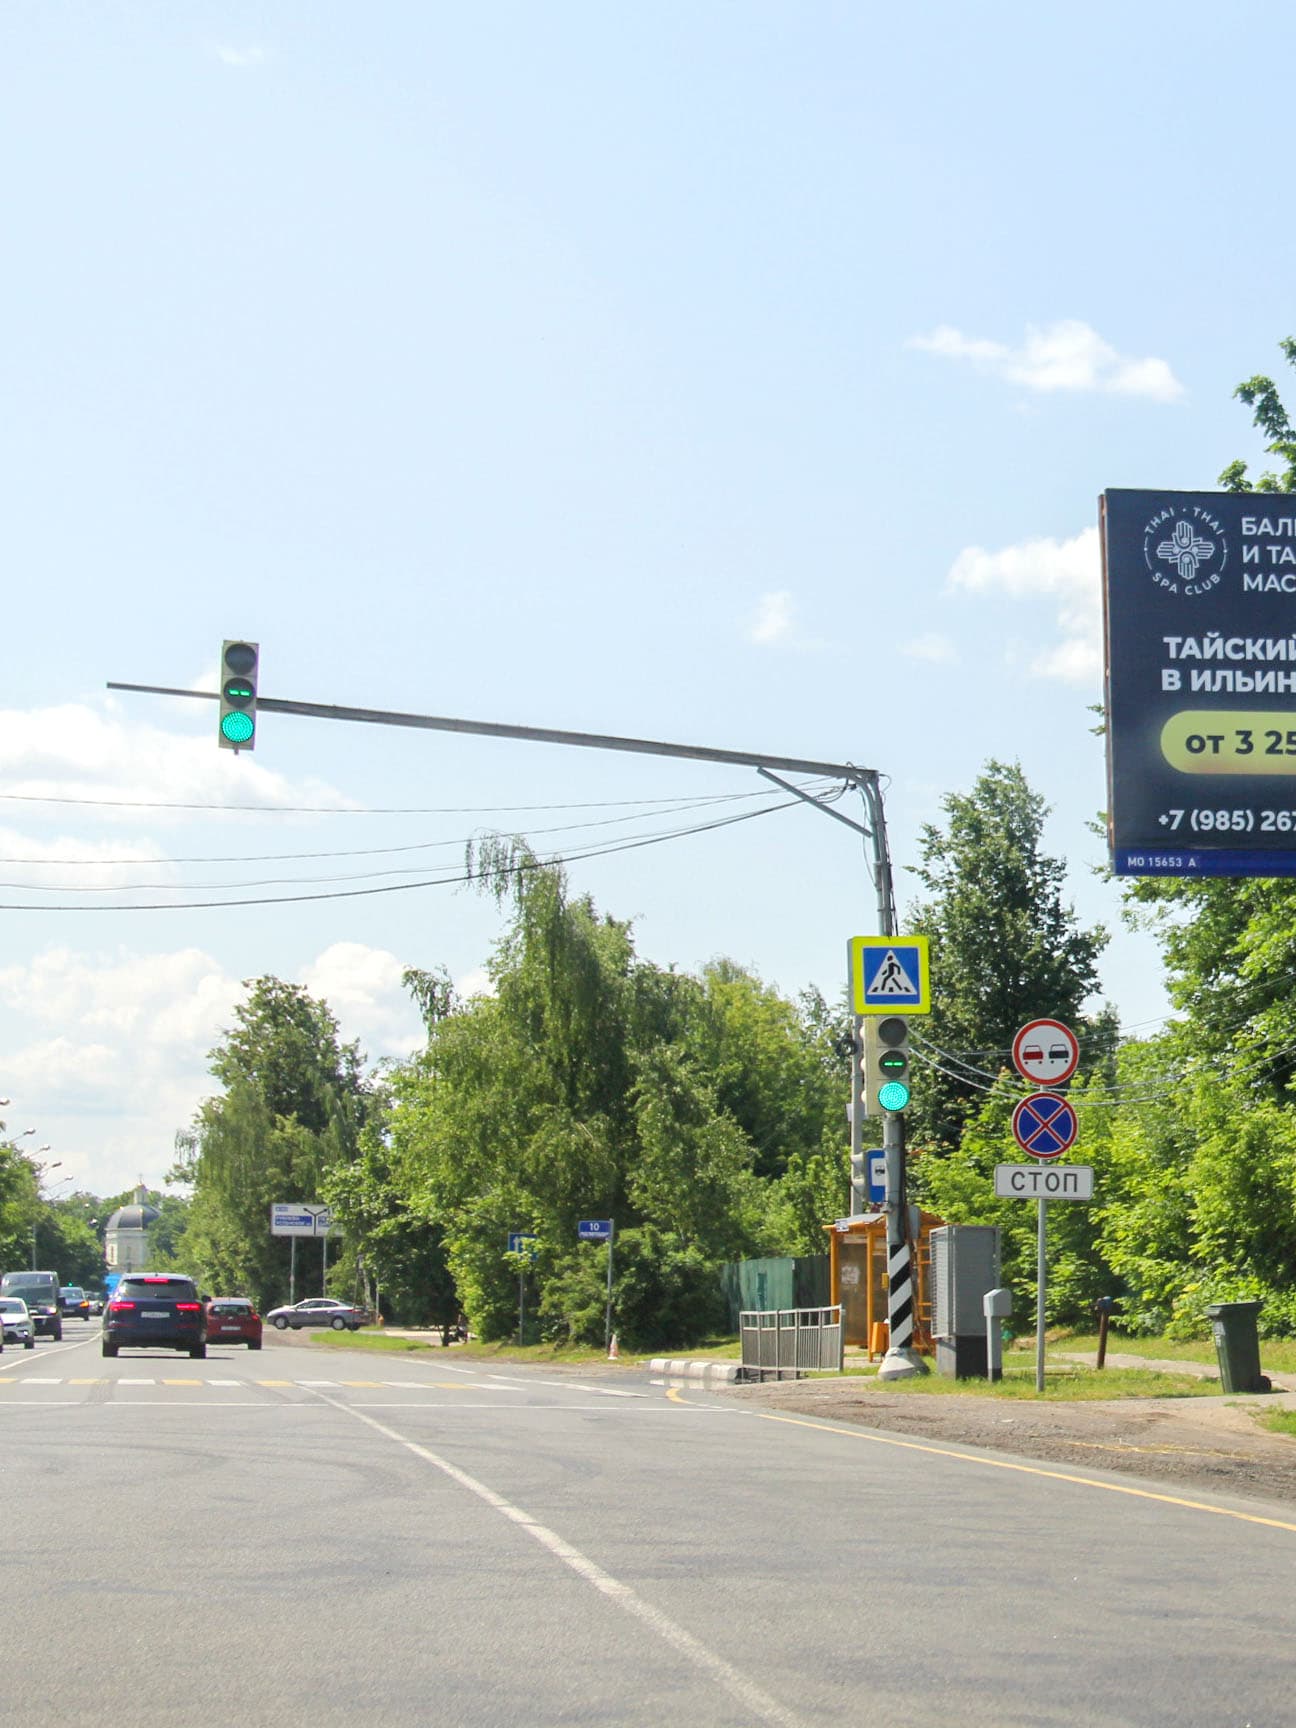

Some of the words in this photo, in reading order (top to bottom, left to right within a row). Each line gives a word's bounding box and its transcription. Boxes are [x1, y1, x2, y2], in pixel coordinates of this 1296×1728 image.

[1144, 507, 1175, 534] THAI
[1193, 507, 1224, 535] THAI
[1242, 546, 1259, 564] И
[1152, 572, 1177, 593] SPA
[1184, 573, 1220, 595] CLUB
[1161, 669, 1182, 691] В
[1185, 734, 1225, 754] от
[1235, 730, 1254, 754] 3
[1158, 810, 1184, 831] +7
[1190, 810, 1254, 832] (985)
[1149, 857, 1182, 867] 15653
[1011, 1171, 1078, 1192] СТОП
[589, 1222, 600, 1231] 10
